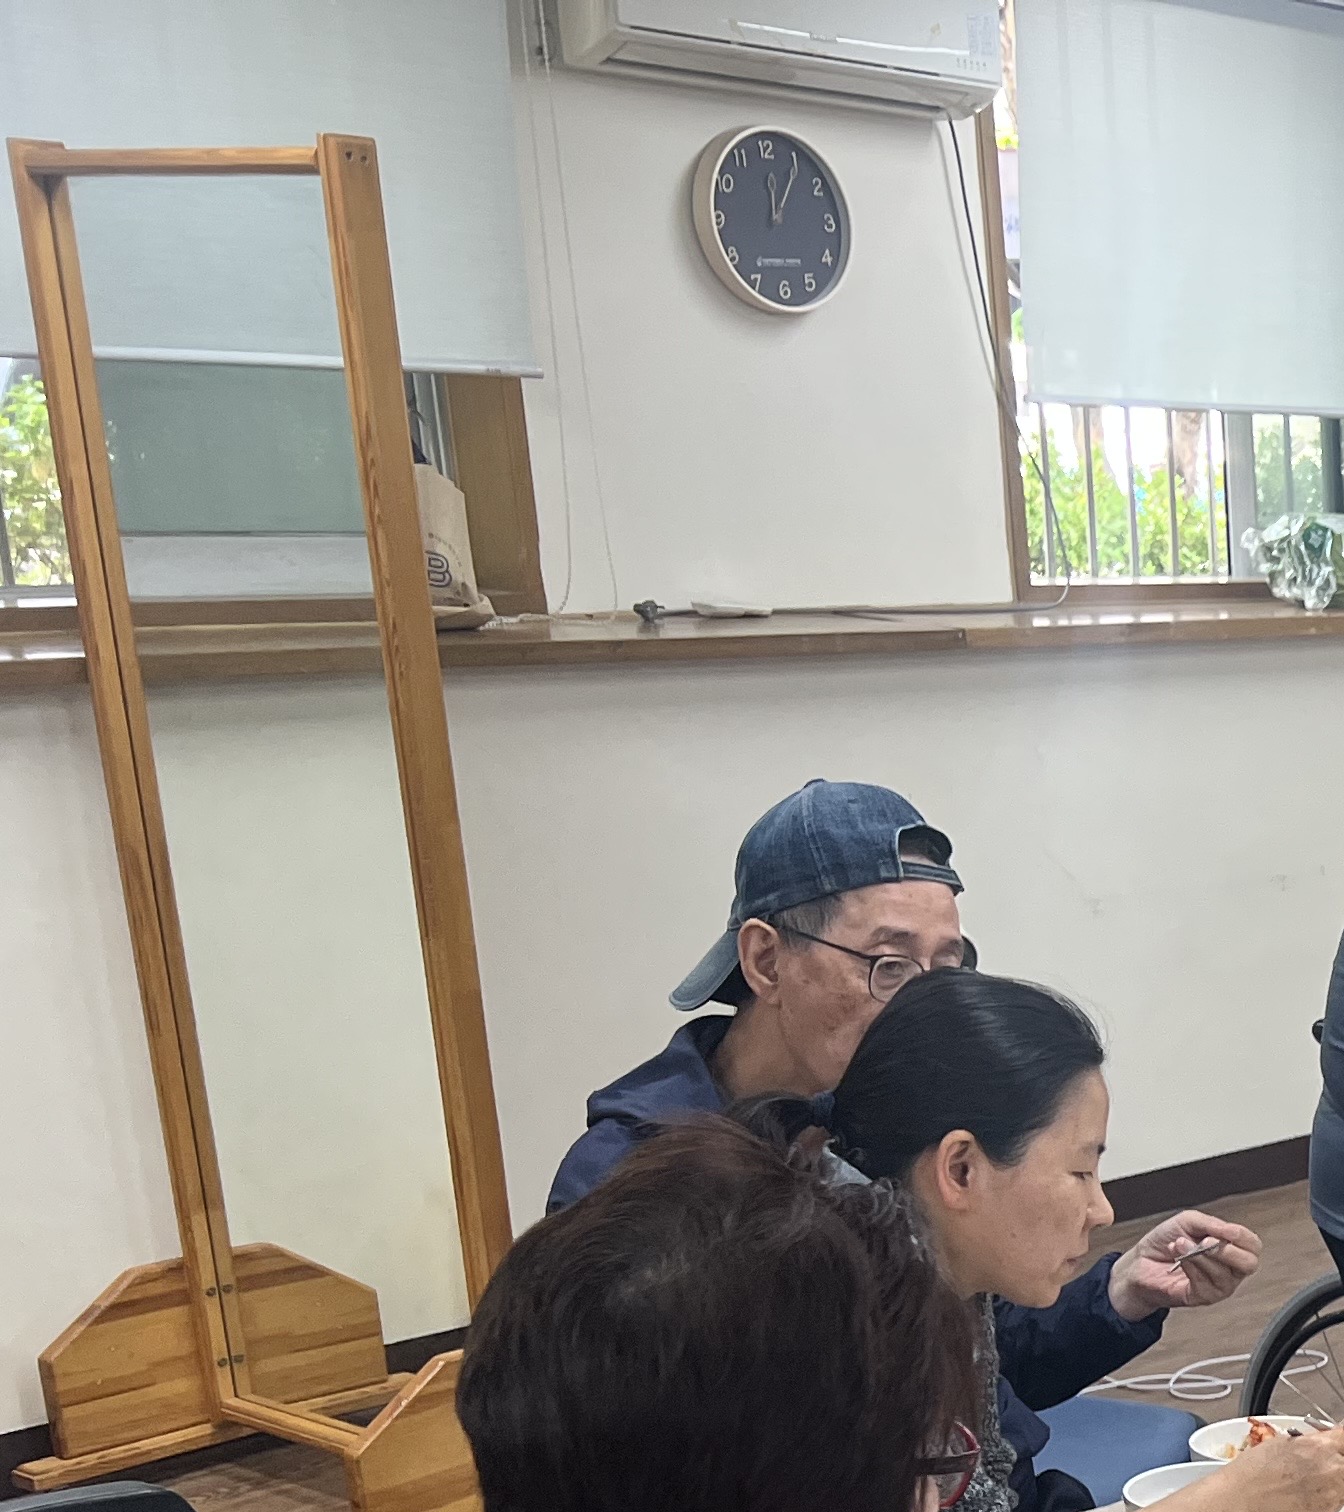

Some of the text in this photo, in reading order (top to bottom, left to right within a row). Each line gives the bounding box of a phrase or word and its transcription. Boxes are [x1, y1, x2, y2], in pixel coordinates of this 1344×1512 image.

[733, 148, 747, 168] 11
[758, 140, 775, 160] 12
[717, 173, 734, 193] 10
[812, 177, 823, 197] 2
[715, 209, 725, 230] 9
[823, 213, 836, 233] 3
[727, 245, 739, 266] 8
[821, 248, 833, 268] 4
[751, 273, 762, 293] 7
[779, 280, 791, 300] 6
[804, 273, 816, 292] 5
